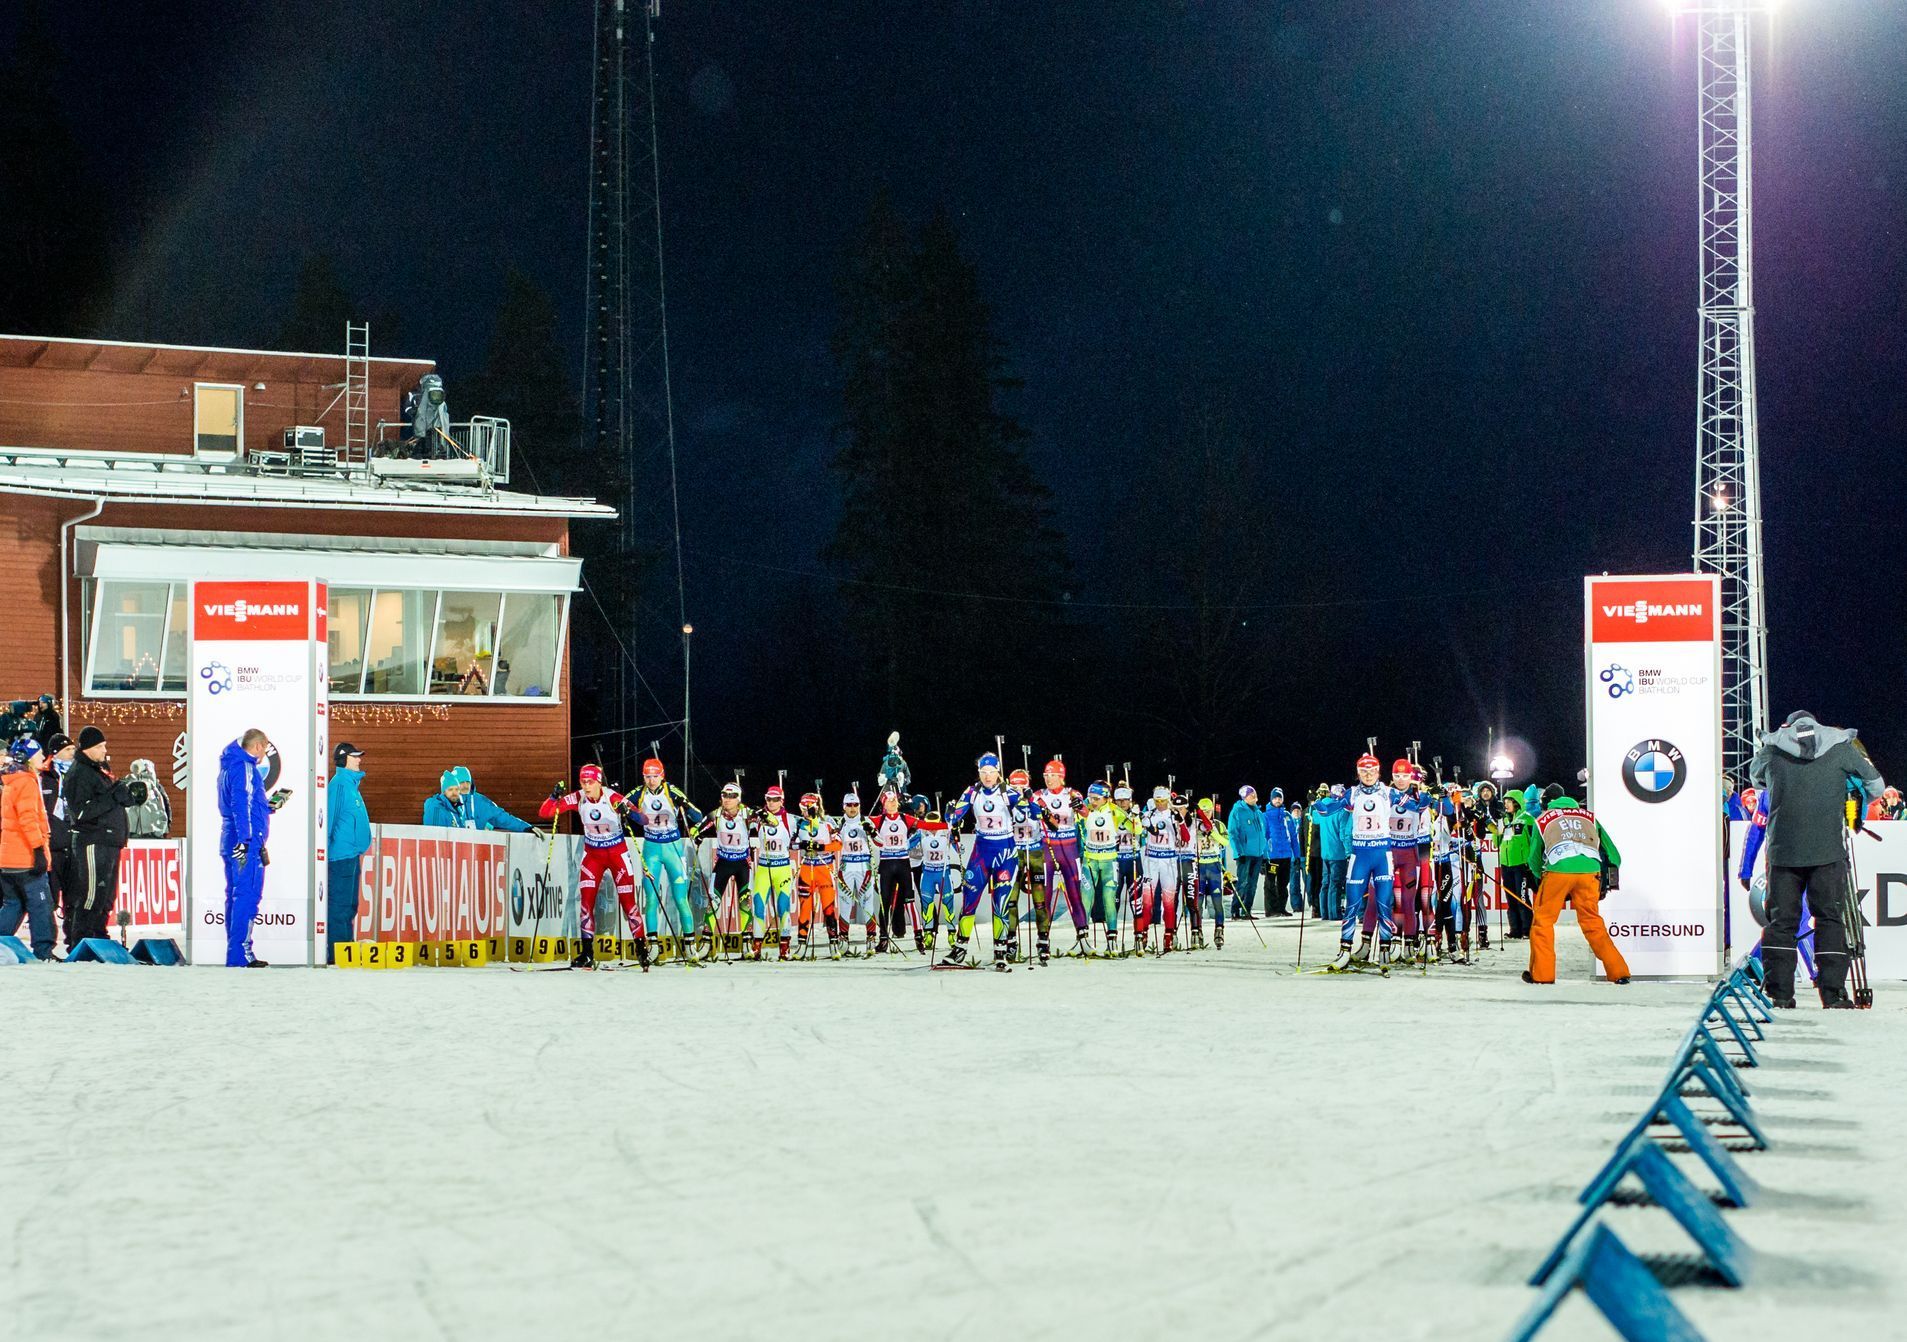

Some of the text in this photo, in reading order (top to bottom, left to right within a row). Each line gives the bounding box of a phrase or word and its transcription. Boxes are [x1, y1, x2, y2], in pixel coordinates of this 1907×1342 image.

[203, 599, 299, 622] VIESSMANN
[1602, 600, 1702, 623] VIESSMANN
[1638, 669, 1661, 677] BMW
[1627, 740, 1682, 762] BMW
[654, 815, 661, 826] 4
[987, 817, 993, 829] 2
[1366, 817, 1372, 830] 3
[1397, 818, 1404, 830] 6
[594, 825, 601, 835] 1
[1018, 827, 1025, 839] 5
[1096, 831, 1104, 841] 11
[727, 834, 733, 845] 7
[766, 840, 777, 851] 10
[849, 841, 858, 852] 16
[889, 836, 899, 846] 19
[1155, 834, 1164, 844] 17
[1367, 839, 1388, 847] xDrive
[930, 851, 939, 861] 22
[118, 859, 180, 915] HAUS
[1187, 872, 1195, 900] JAPAN
[380, 855, 506, 935] BAUHAUS
[527, 872, 563, 921] xDrive
[204, 909, 296, 926] ÖSSUND
[1608, 921, 1705, 937] ÖSTERSUND
[597, 938, 613, 954] 12
[724, 935, 739, 950] 20
[764, 931, 779, 945] 23
[343, 945, 353, 963] 1
[369, 946, 380, 964] 2
[394, 945, 405, 963] 3
[418, 944, 430, 961] 4
[445, 943, 455, 961] 5
[468, 942, 479, 960] 6
[489, 939, 498, 955] 7
[514, 939, 525, 956] 8
[538, 939, 549, 955] 9
